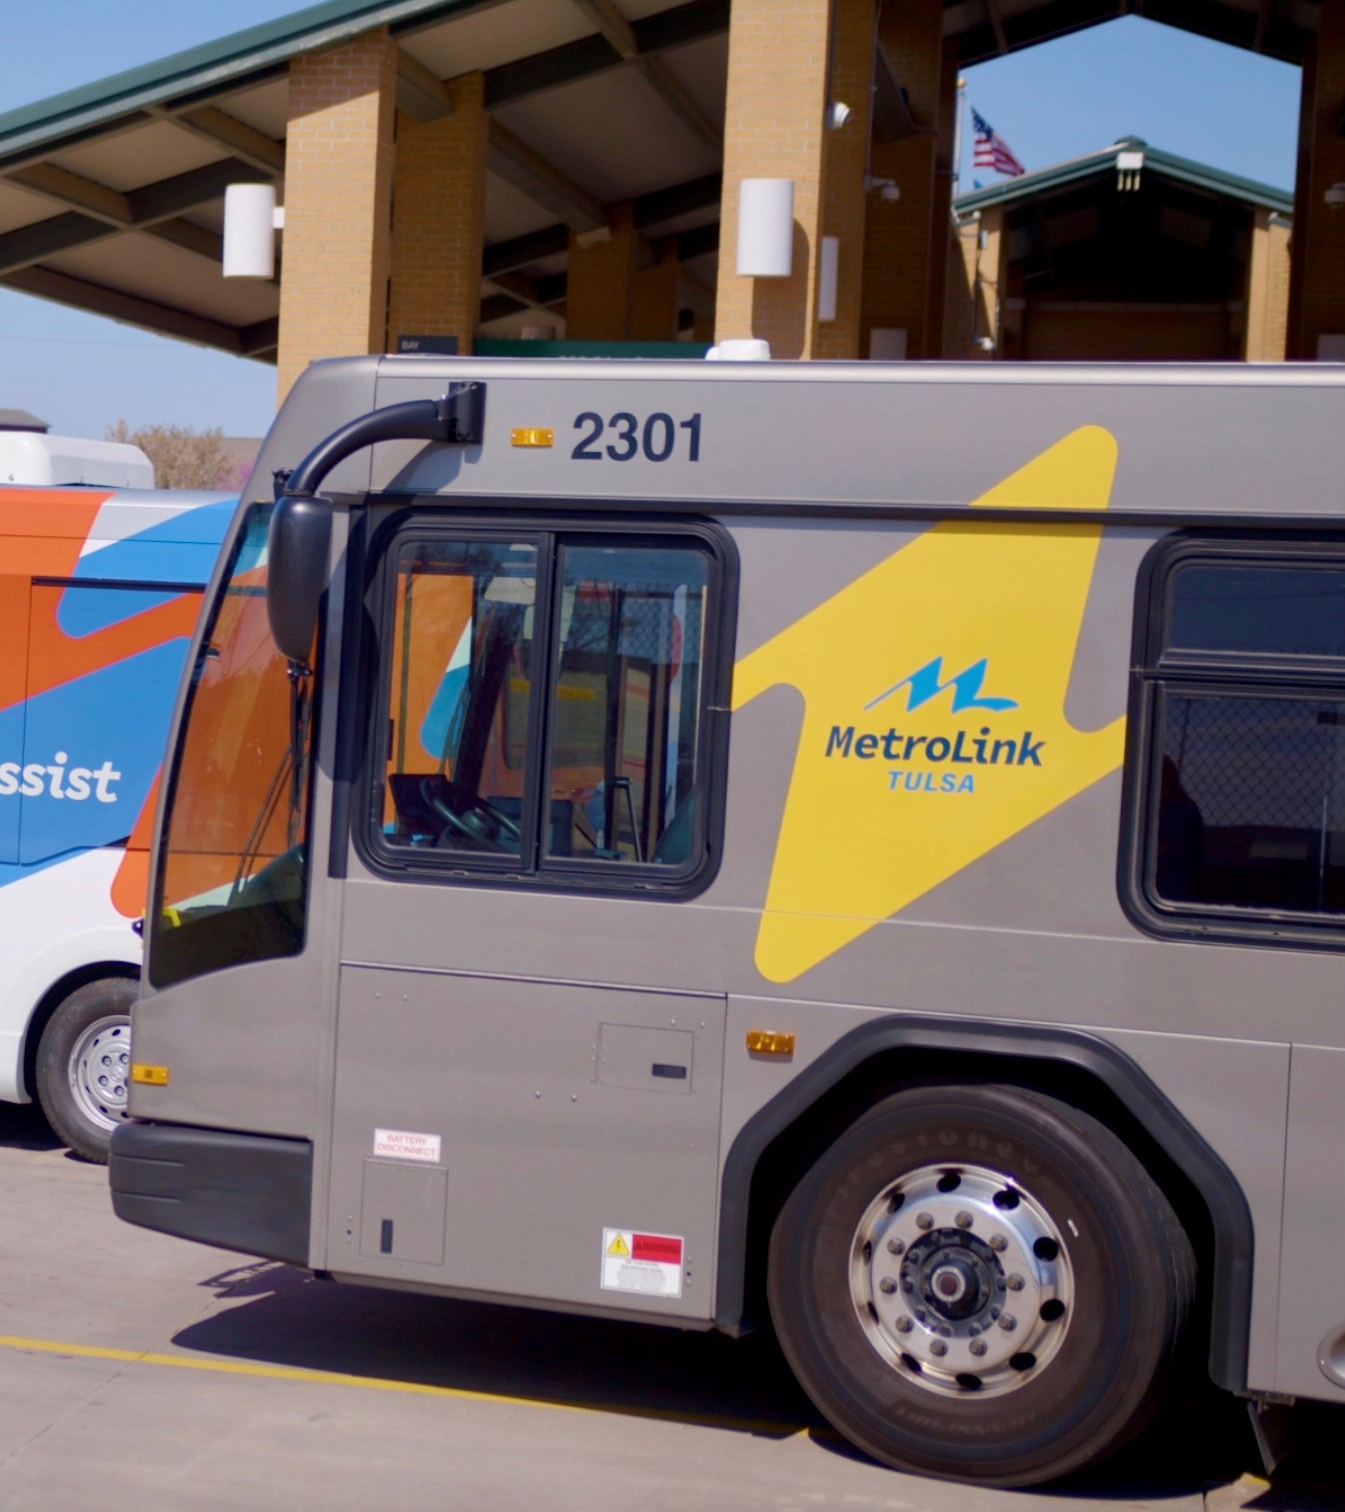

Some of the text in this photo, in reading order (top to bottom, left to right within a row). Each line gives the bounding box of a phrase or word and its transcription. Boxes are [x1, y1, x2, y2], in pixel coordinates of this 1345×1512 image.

[401, 341, 420, 350] BAY
[571, 412, 701, 462] 2301
[825, 726, 1047, 767] MetroLink
[888, 771, 975, 793] TULSA
[387, 1134, 426, 1145] BATTERY
[378, 1143, 435, 1156] DISCONNECT
